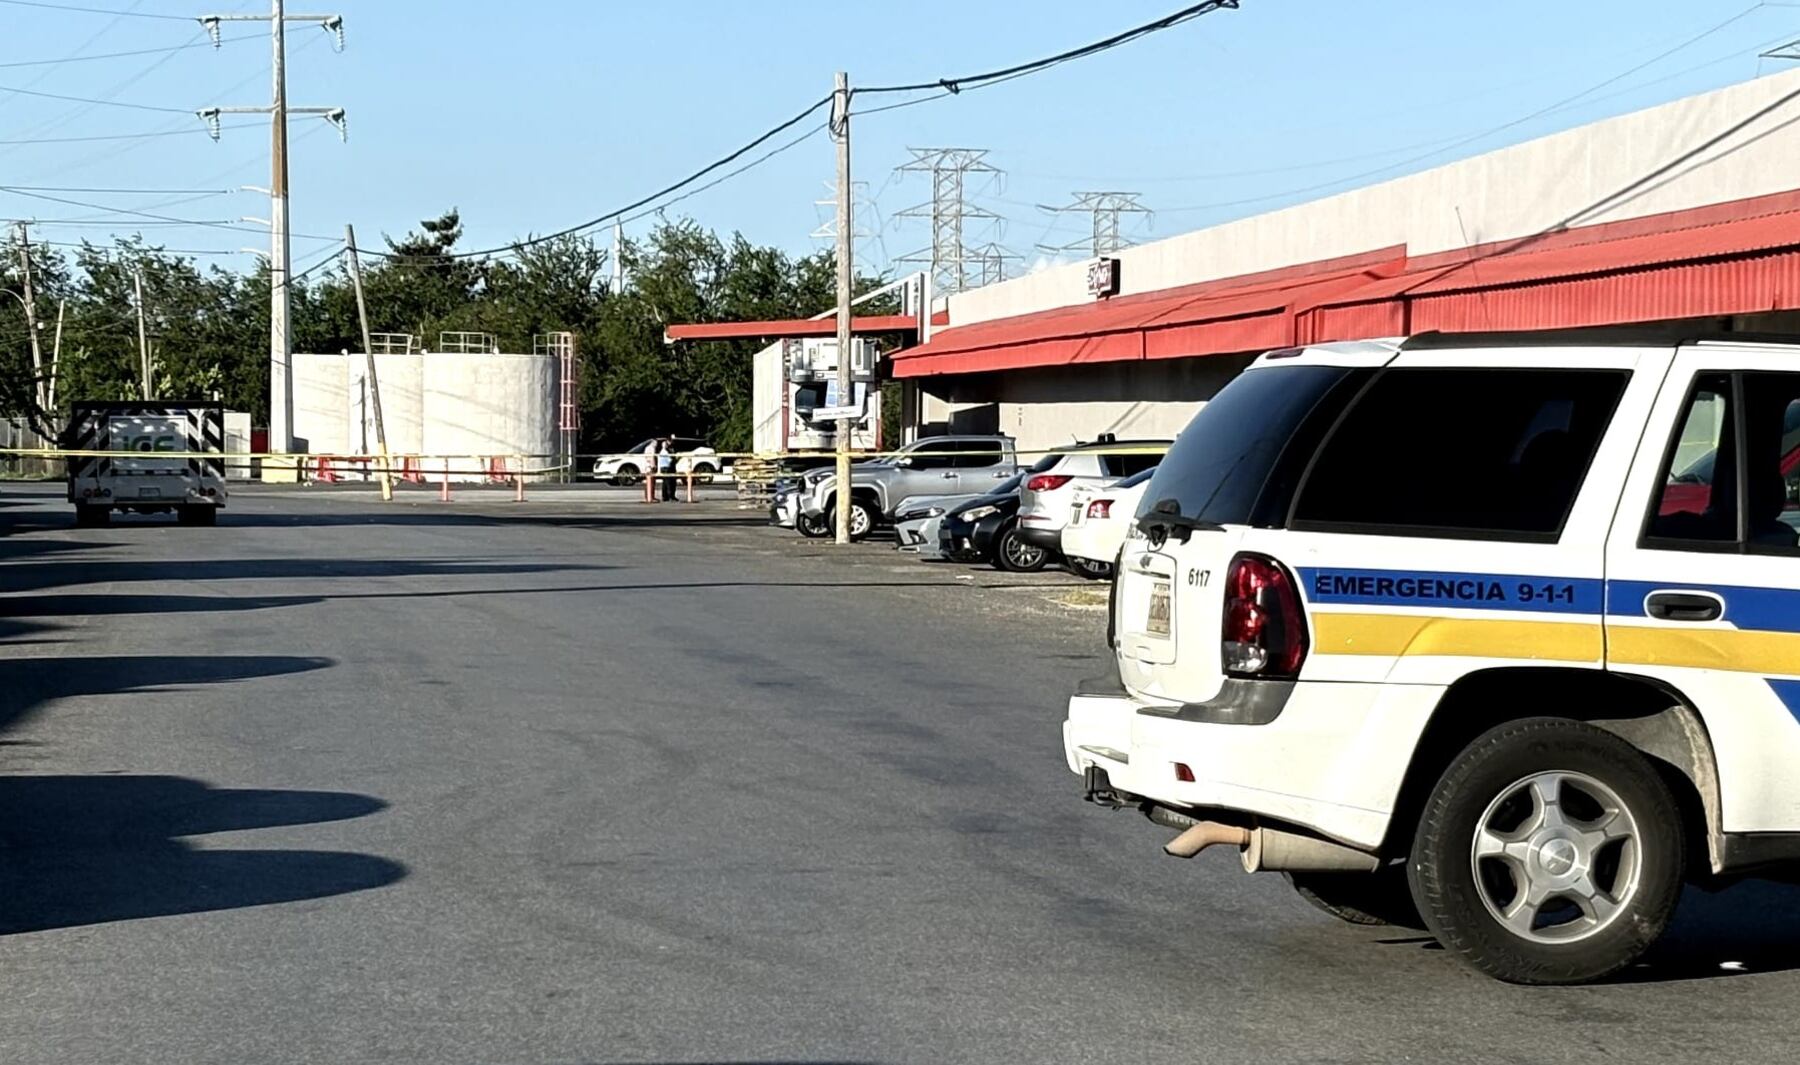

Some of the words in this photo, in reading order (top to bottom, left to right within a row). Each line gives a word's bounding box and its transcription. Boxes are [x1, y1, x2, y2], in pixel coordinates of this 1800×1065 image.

[1187, 568, 1211, 587] 6117
[1315, 575, 1506, 601] EMERGENCIA
[1517, 583, 1574, 604] 9-1-1
